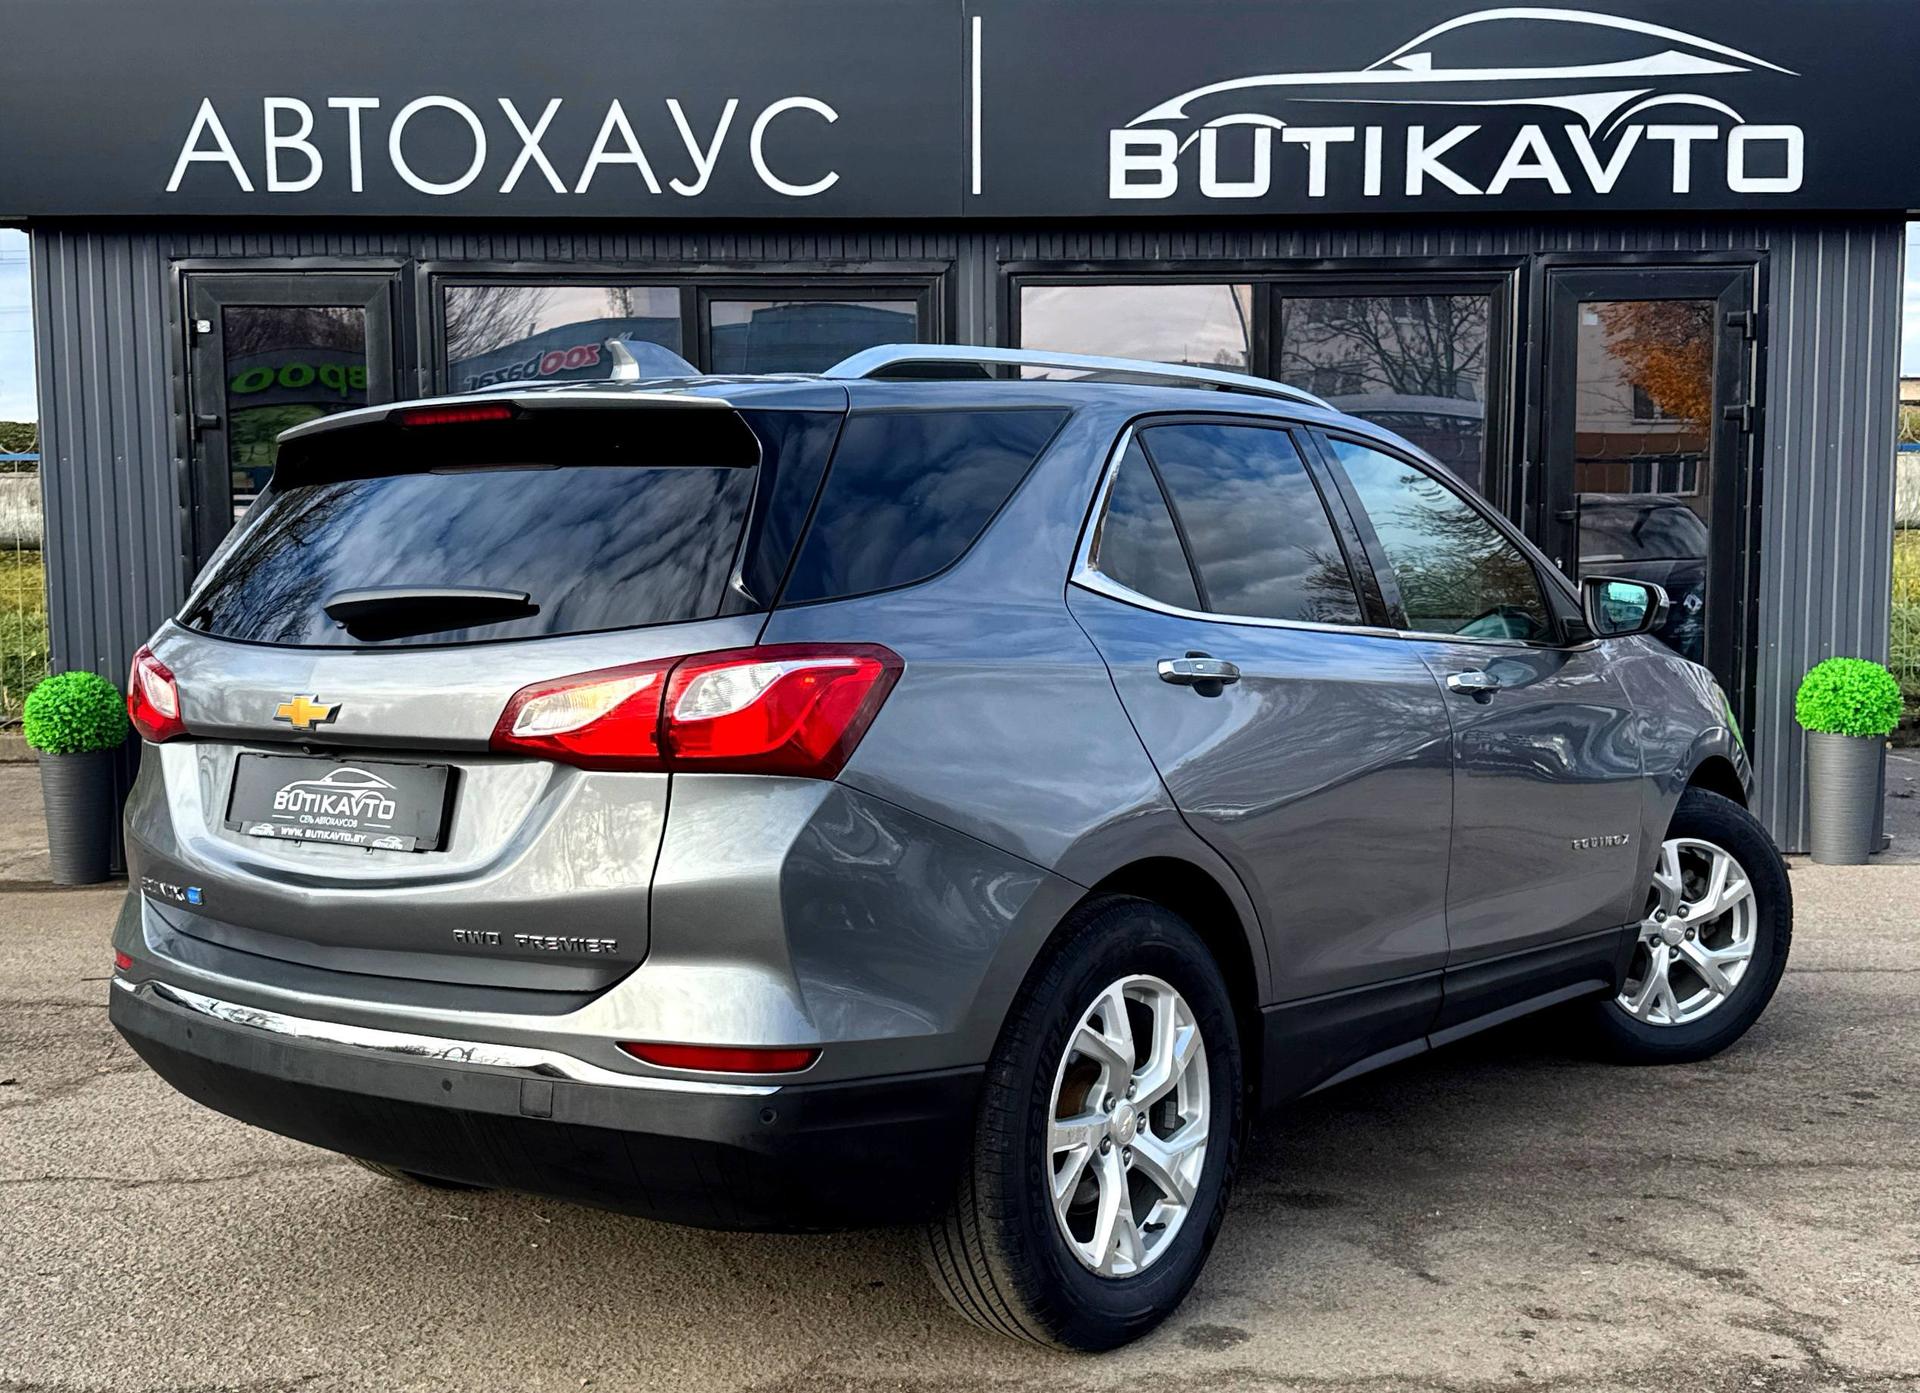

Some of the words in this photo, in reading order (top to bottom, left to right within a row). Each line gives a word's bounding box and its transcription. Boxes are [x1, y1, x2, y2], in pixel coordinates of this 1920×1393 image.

[165, 95, 840, 197] АВТОХАУС
[1108, 123, 1804, 200] BUTIKAVTO
[273, 789, 396, 820] BUTIKAVTO
[453, 929, 500, 945] AWD
[514, 934, 617, 953] PREMIER
